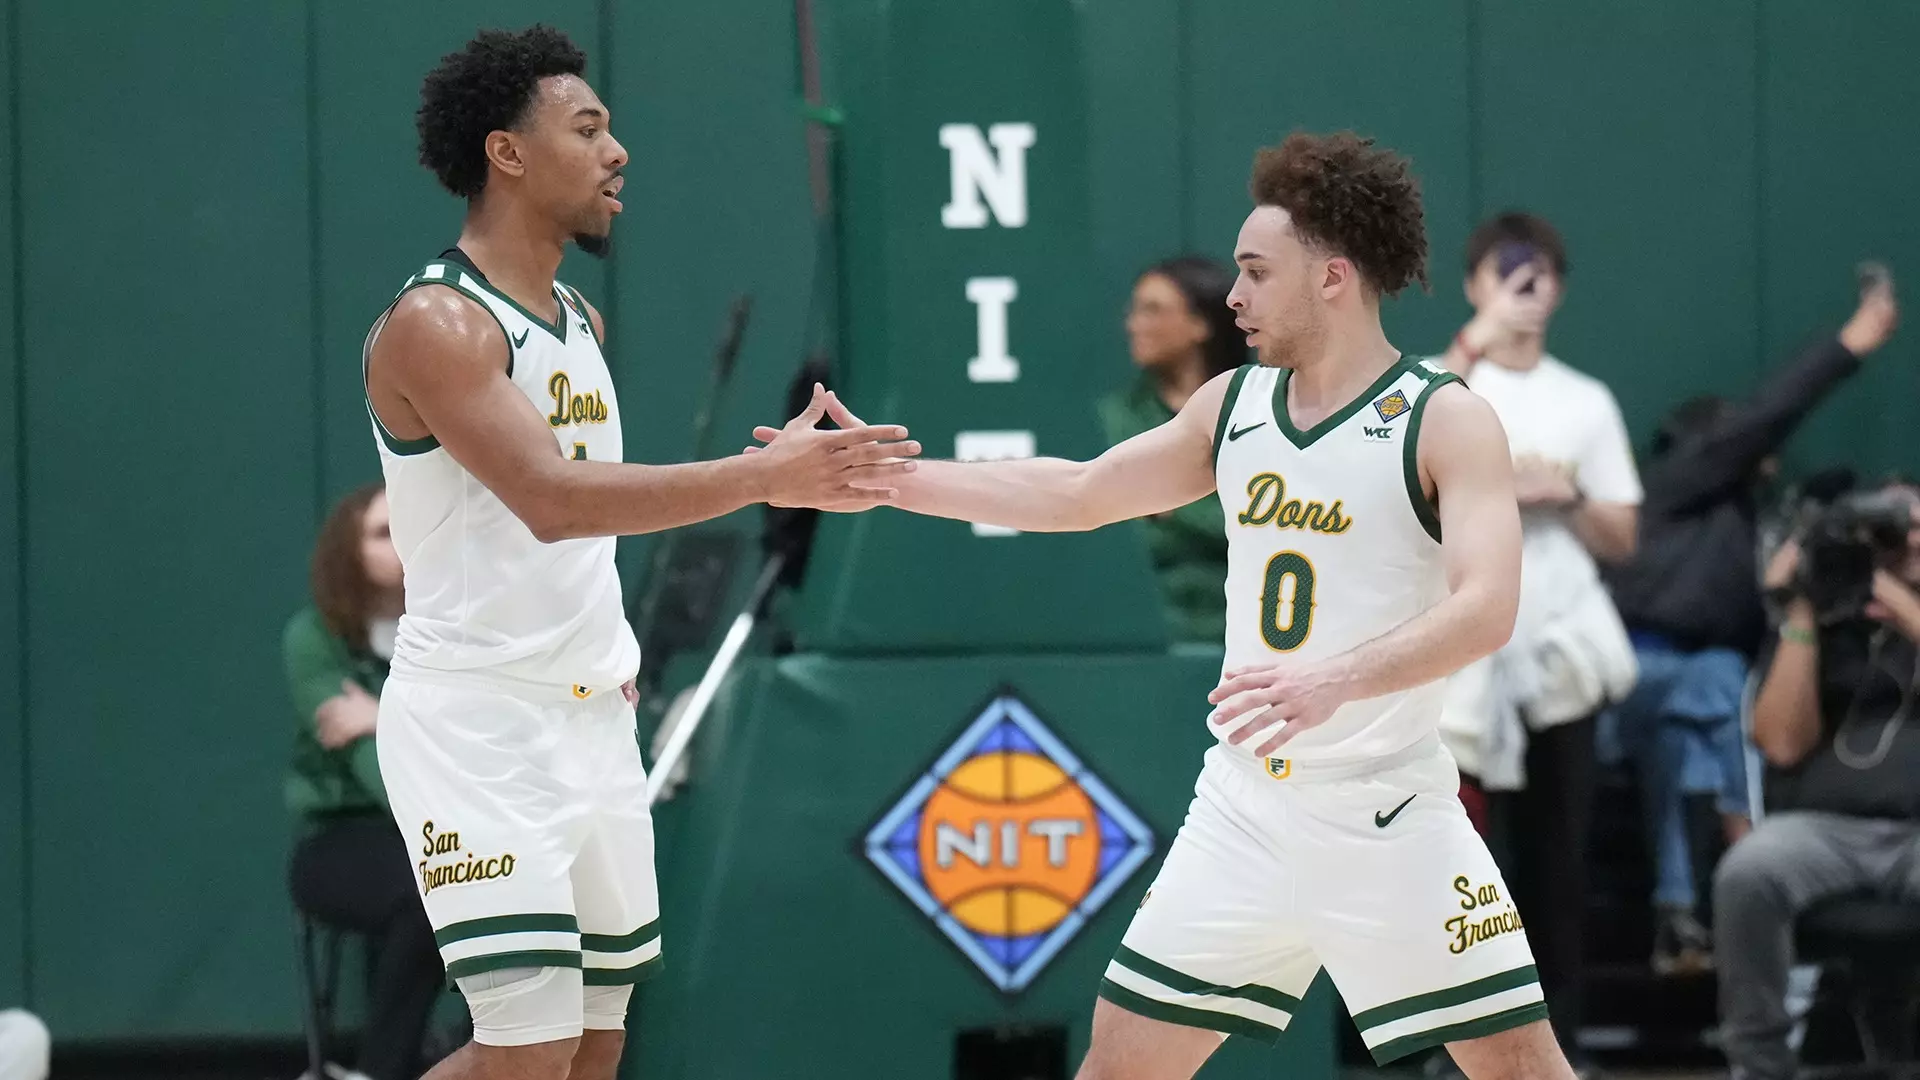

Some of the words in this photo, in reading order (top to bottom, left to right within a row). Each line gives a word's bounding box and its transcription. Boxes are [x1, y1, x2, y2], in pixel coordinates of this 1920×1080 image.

[548, 370, 608, 428] Dons
[1238, 472, 1353, 535] Dons
[1259, 549, 1318, 653] 0
[421, 818, 461, 858] San
[936, 819, 1084, 869] NIT
[418, 852, 516, 897] Francisco
[1452, 874, 1501, 911] San
